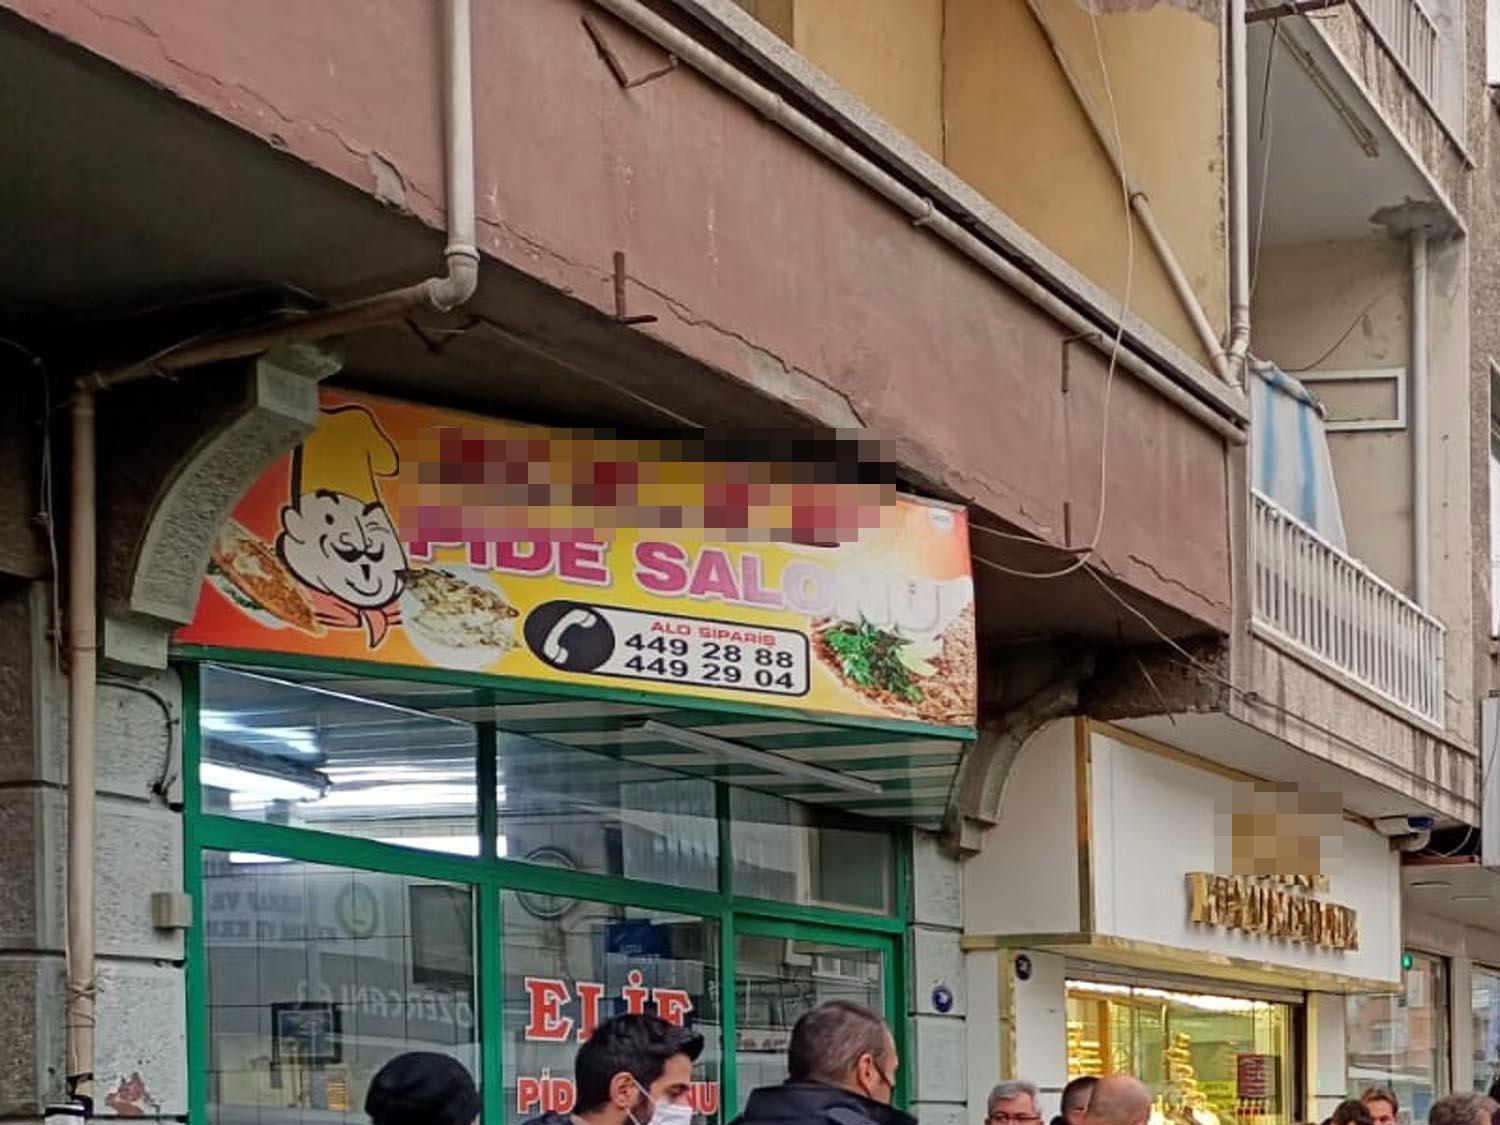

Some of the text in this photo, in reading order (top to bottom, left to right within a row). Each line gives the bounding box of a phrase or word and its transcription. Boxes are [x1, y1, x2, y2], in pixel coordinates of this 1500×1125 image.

[624, 634, 793, 668] 449 28 88
[624, 655, 793, 689] 449 29 04
[517, 1067, 576, 1114] PİD
